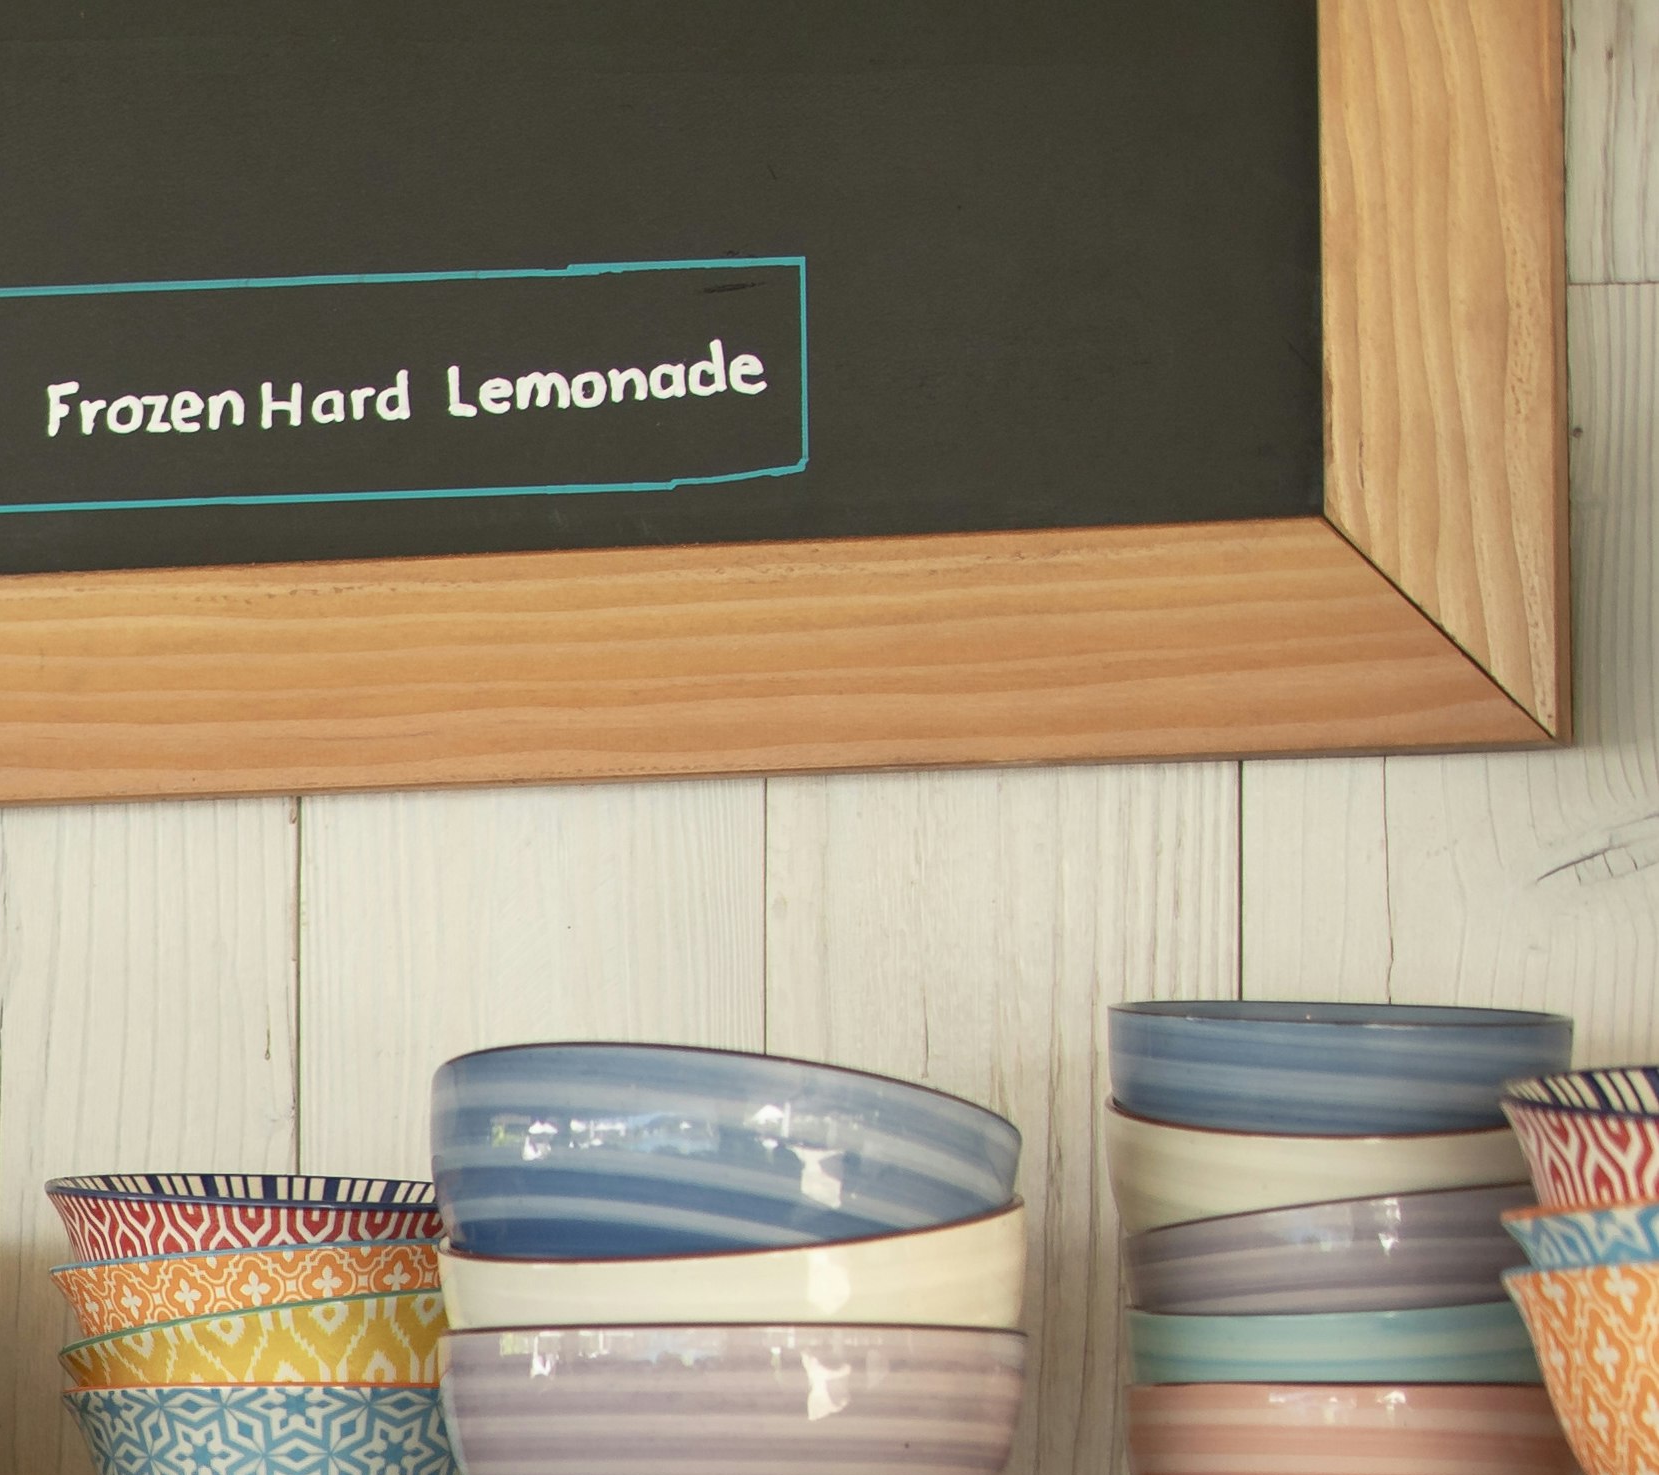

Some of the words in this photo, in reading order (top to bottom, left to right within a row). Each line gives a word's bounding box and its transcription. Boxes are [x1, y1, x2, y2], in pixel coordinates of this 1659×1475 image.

[44, 375, 248, 442] Frozen
[258, 366, 413, 433] Hard
[445, 335, 770, 421] Lemonade
